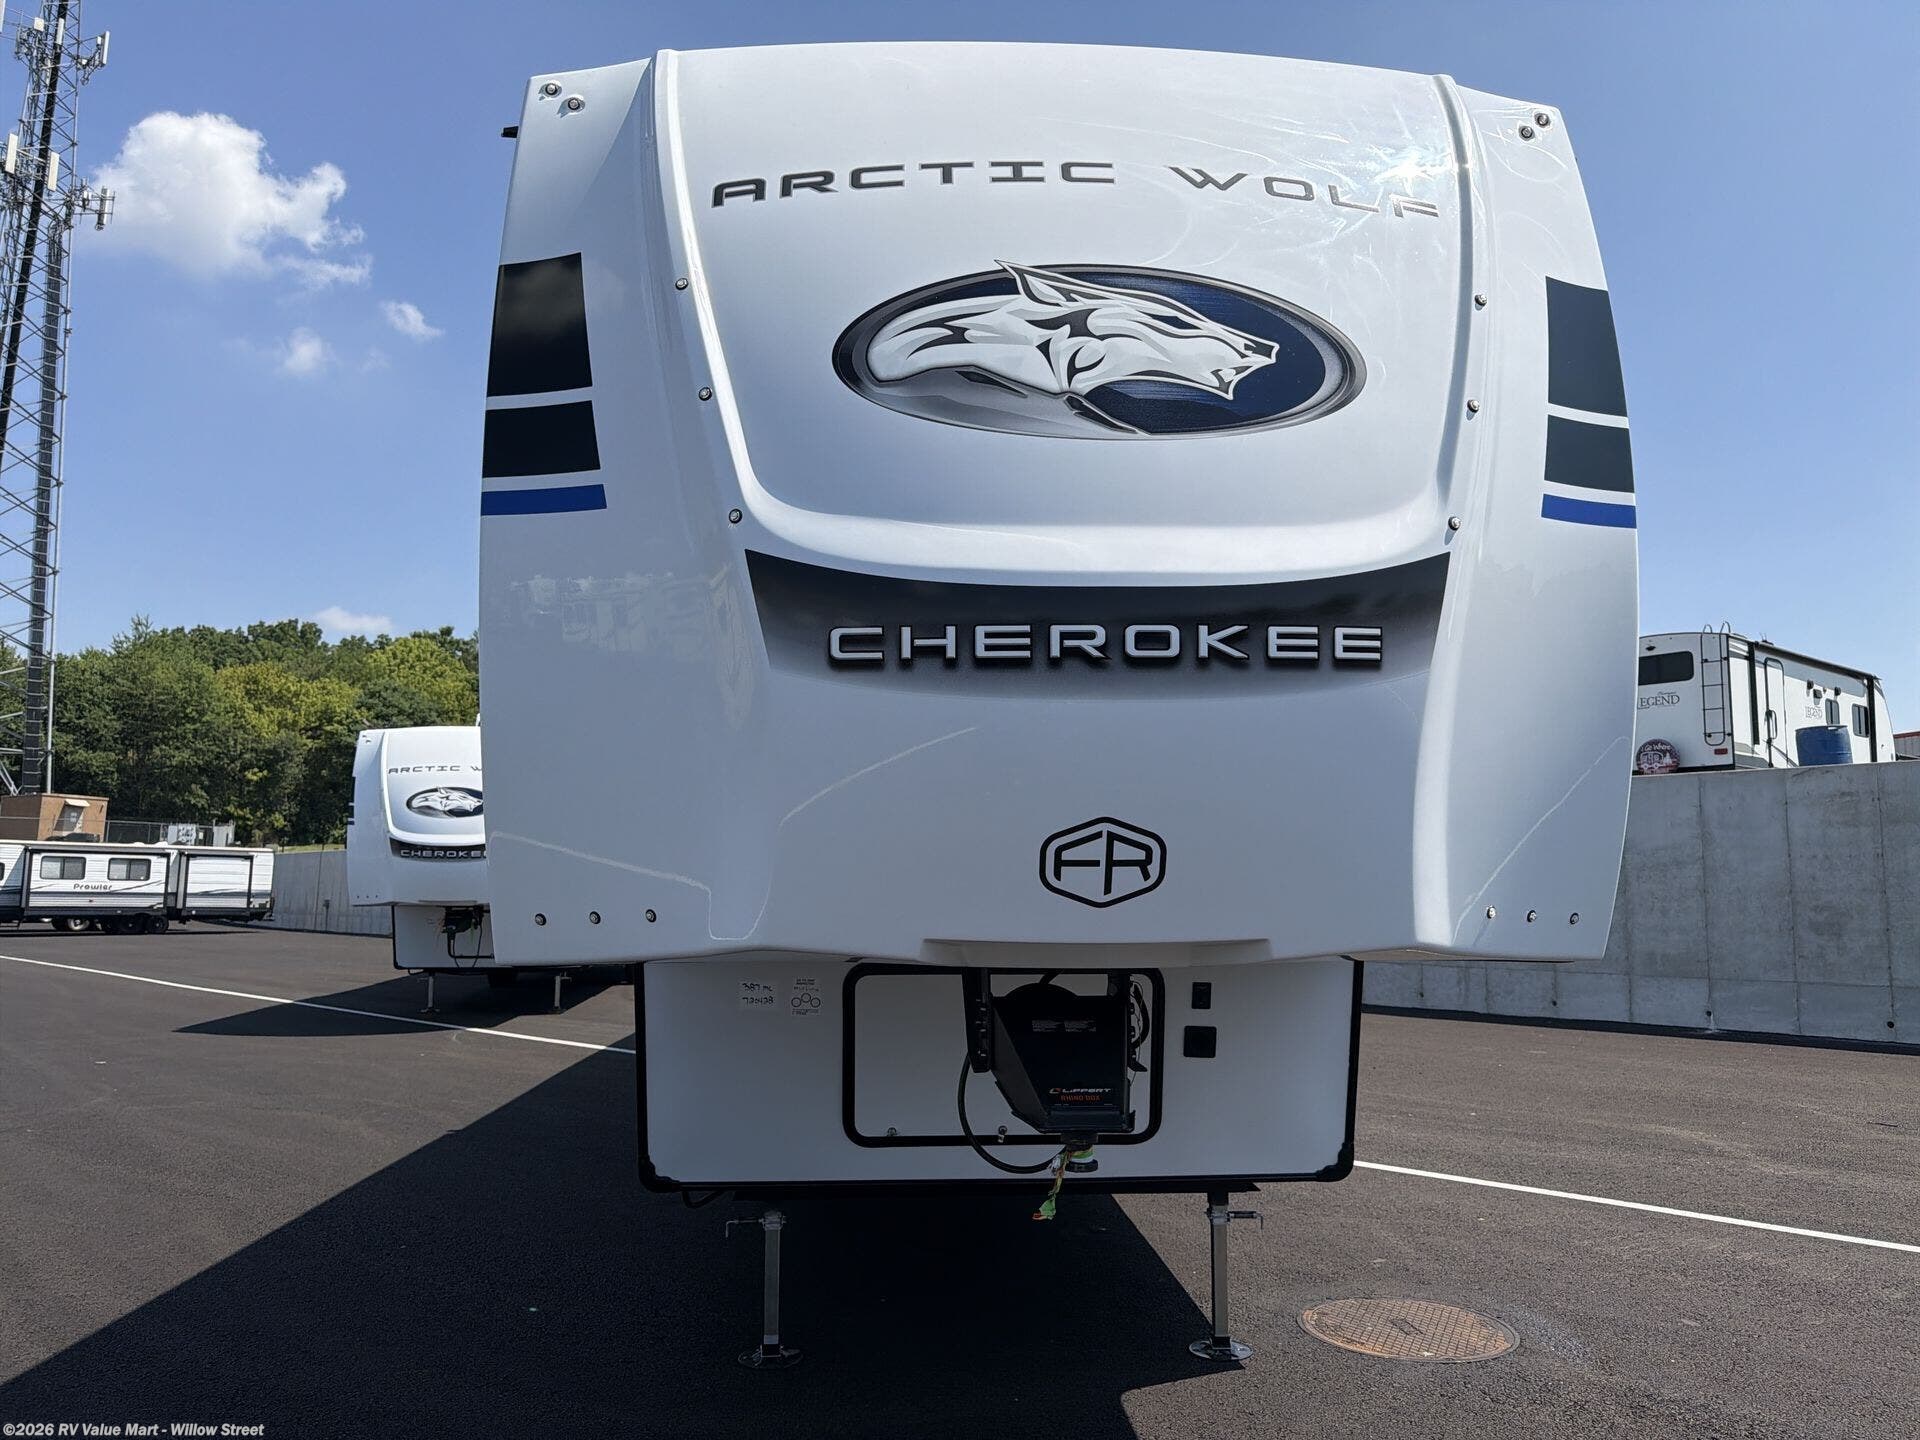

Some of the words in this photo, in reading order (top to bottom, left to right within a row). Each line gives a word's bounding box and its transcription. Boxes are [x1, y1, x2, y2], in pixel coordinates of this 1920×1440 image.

[711, 160, 1116, 208] ARCTIC
[1169, 165, 1440, 218] WOLF
[828, 624, 1384, 661] CHEROKEE
[388, 765, 460, 774] ARCTIC
[401, 849, 486, 857] CHEROKE
